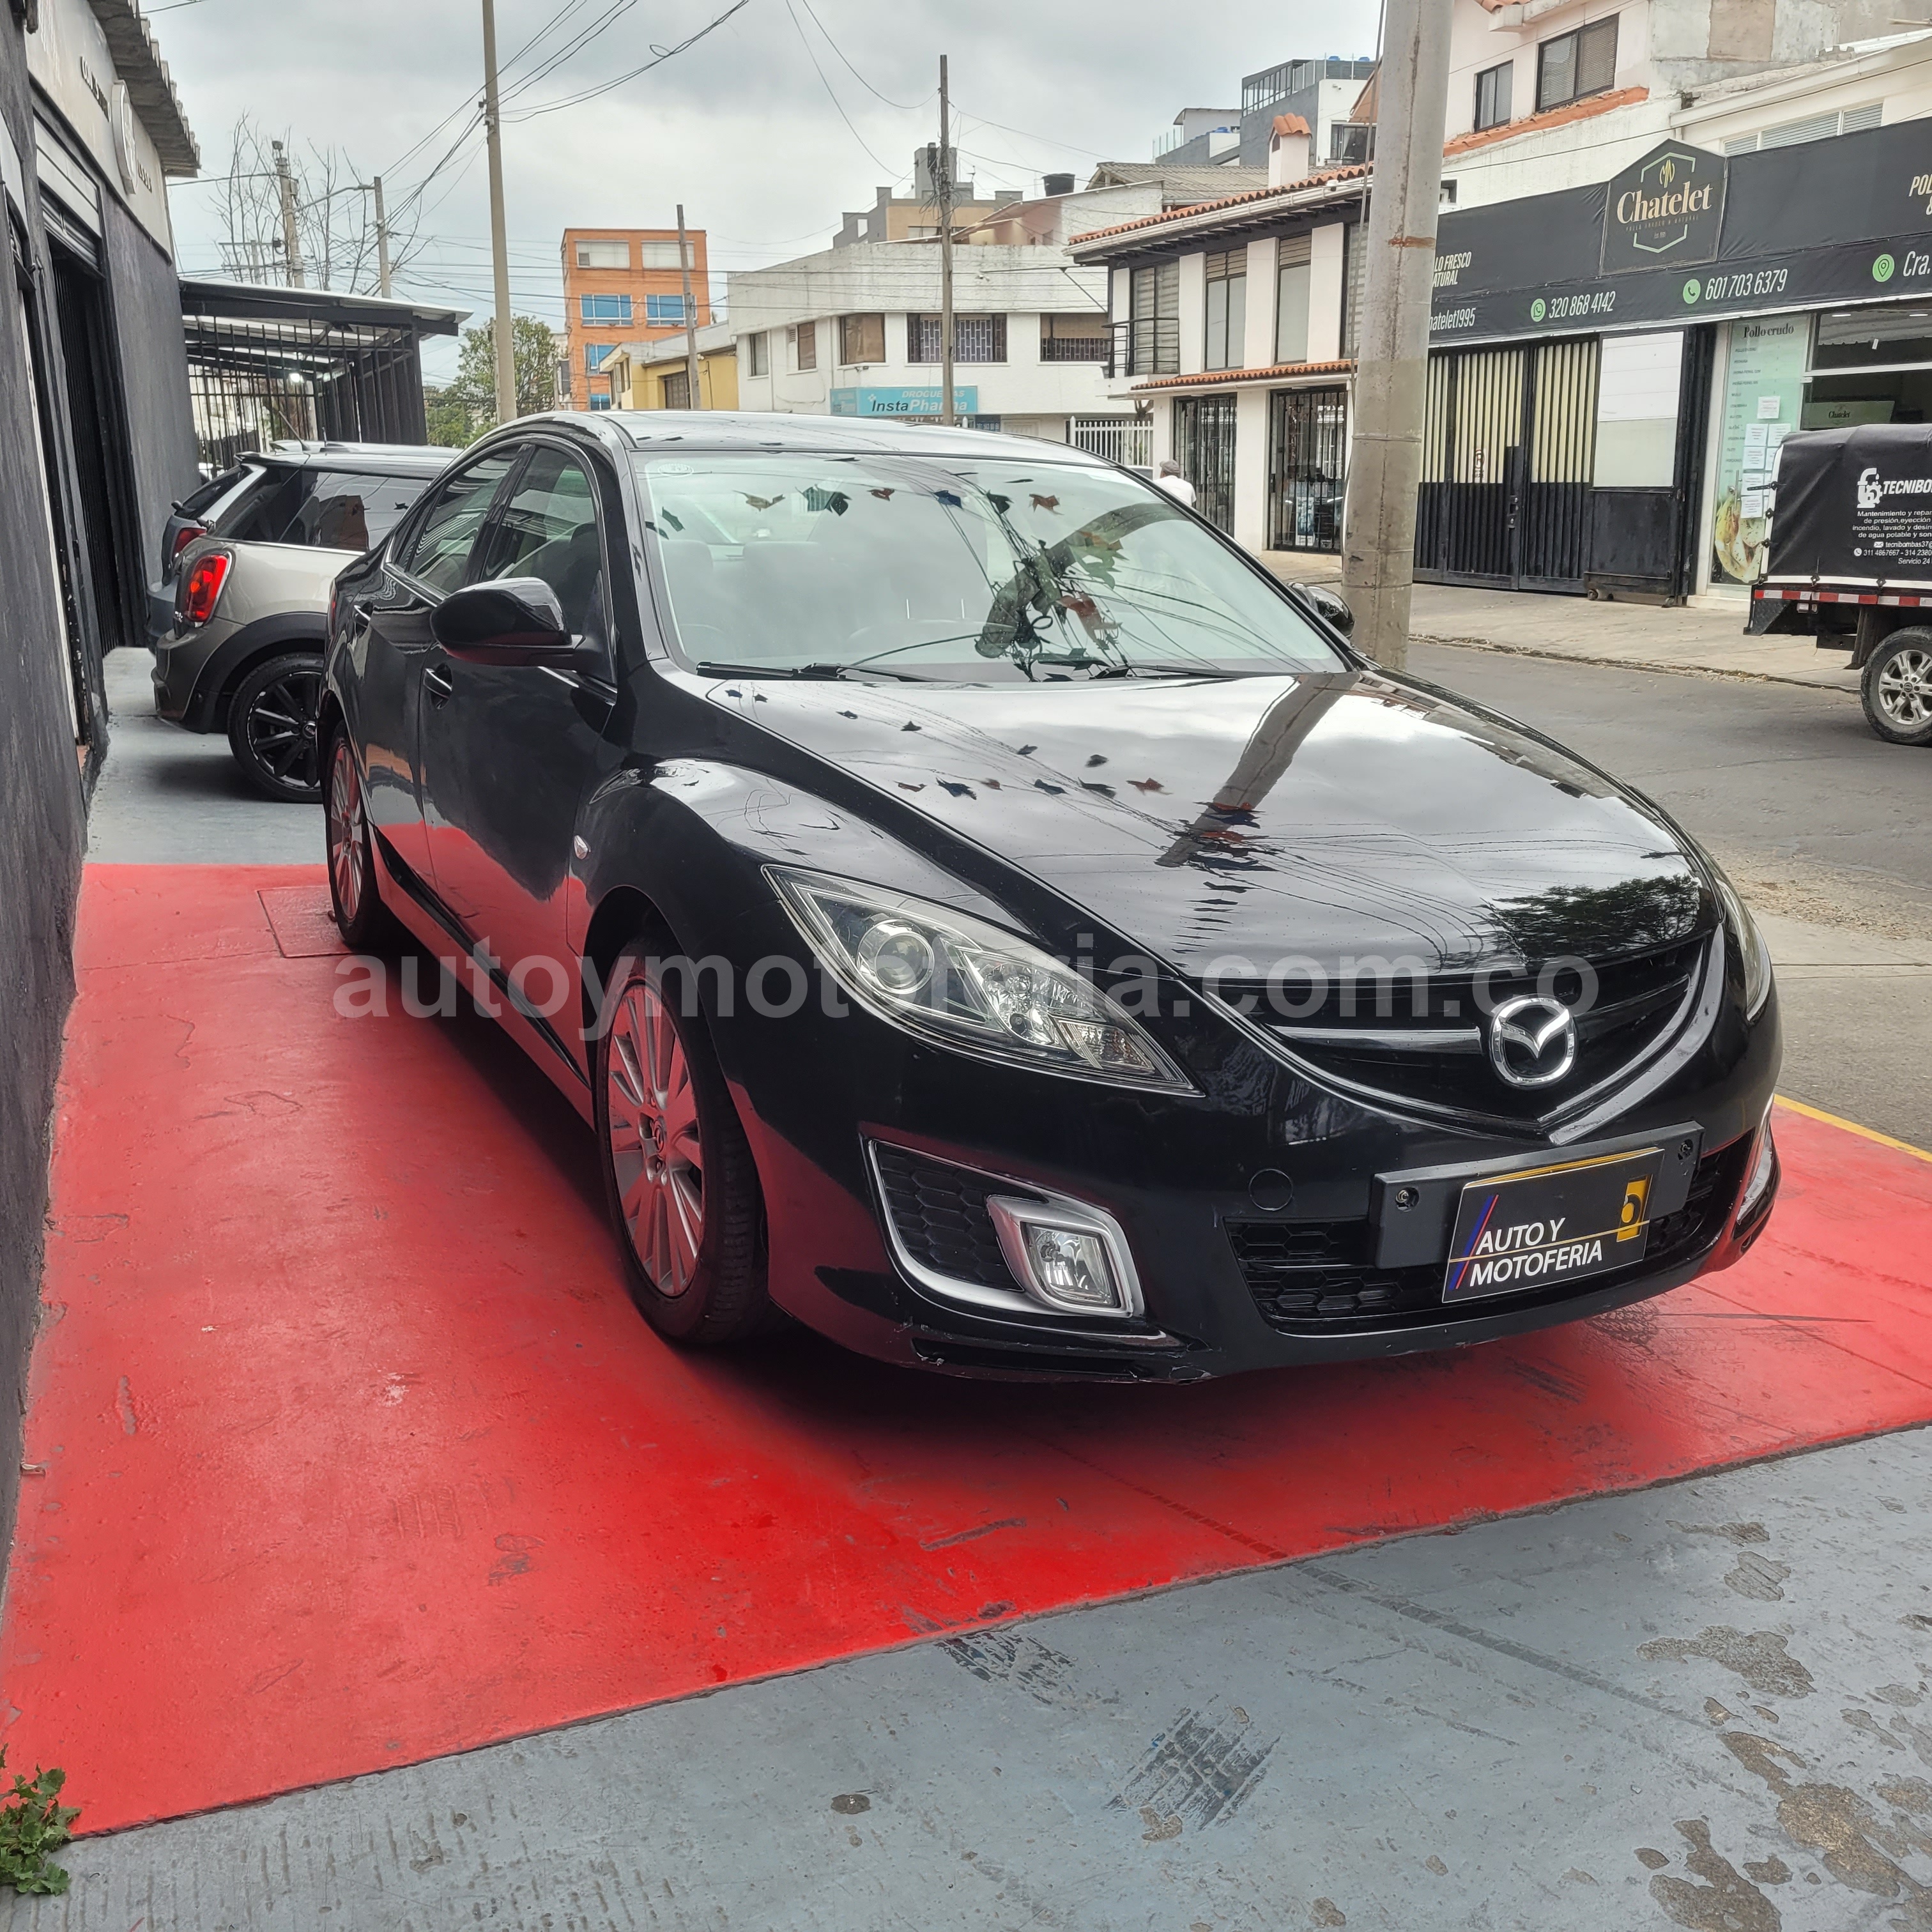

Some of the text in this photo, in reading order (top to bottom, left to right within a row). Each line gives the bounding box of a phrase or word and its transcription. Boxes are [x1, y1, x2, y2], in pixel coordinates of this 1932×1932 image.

[1617, 181, 1713, 224] Chatelet
[1445, 252, 1472, 270] FRESCO
[1903, 250, 1931, 277] Cra.
[1432, 270, 1459, 288] ATURAL
[1705, 268, 1788, 300] 601 703 6379
[1549, 291, 1616, 319] 320 868 4142
[1744, 323, 1794, 338] Pollo crudo
[1883, 479, 1932, 494] TECNIBO
[1476, 1218, 1566, 1255] AUTO Y
[1469, 1240, 1602, 1287] MOTOFERIA
